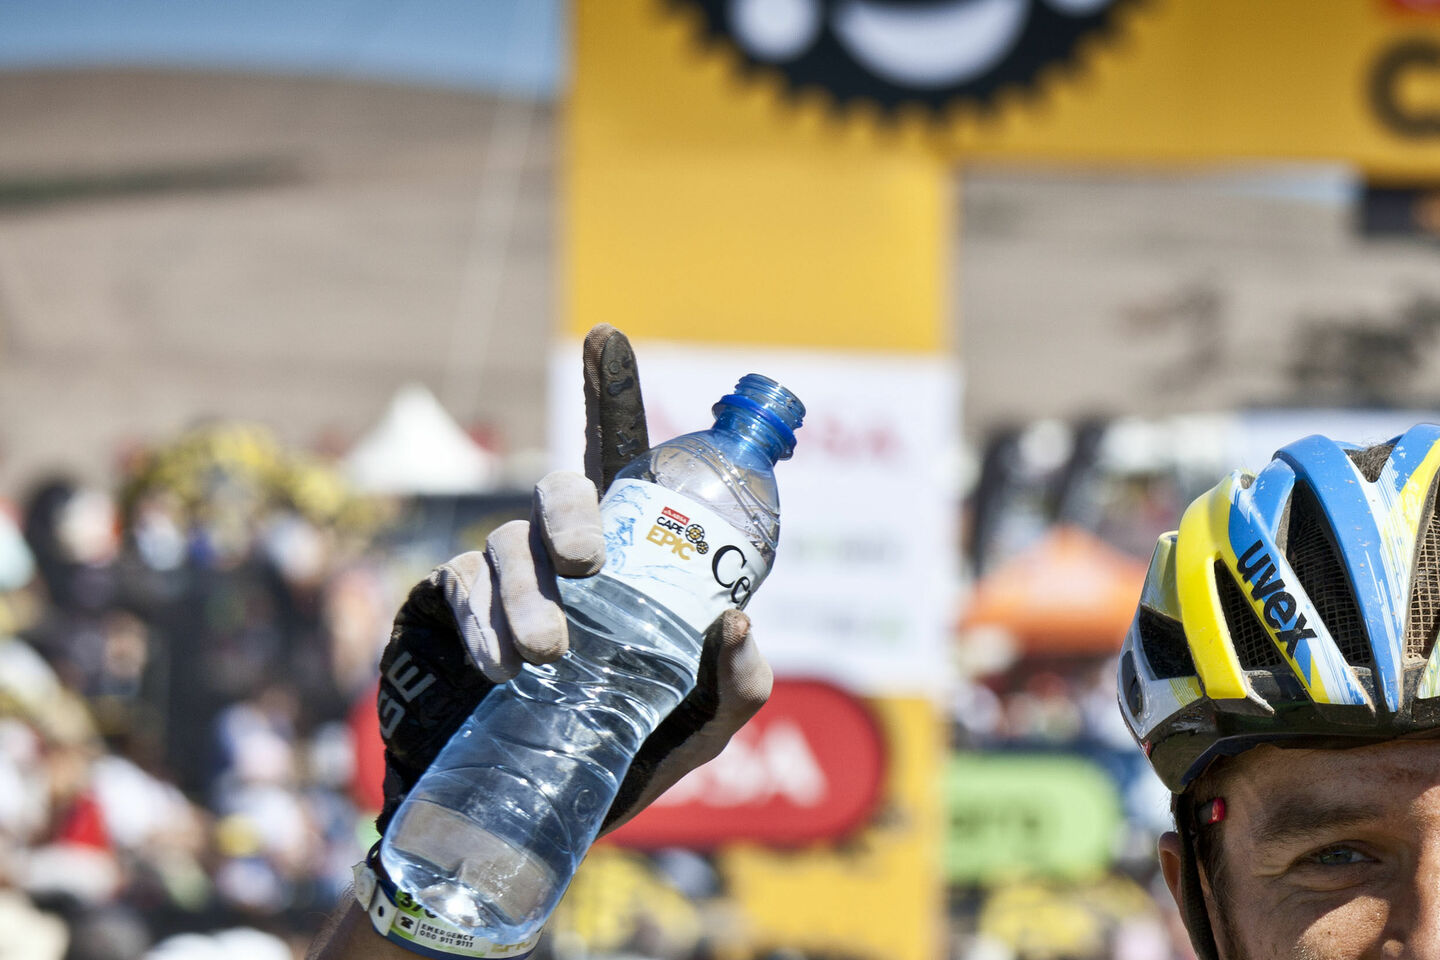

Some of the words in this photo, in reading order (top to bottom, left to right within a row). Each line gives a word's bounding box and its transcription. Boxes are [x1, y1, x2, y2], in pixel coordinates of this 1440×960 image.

[656, 516, 684, 536] CAPE
[646, 525, 696, 561] EPIC
[1236, 539, 1317, 657] uvex
[421, 924, 475, 941] EMERGENCY
